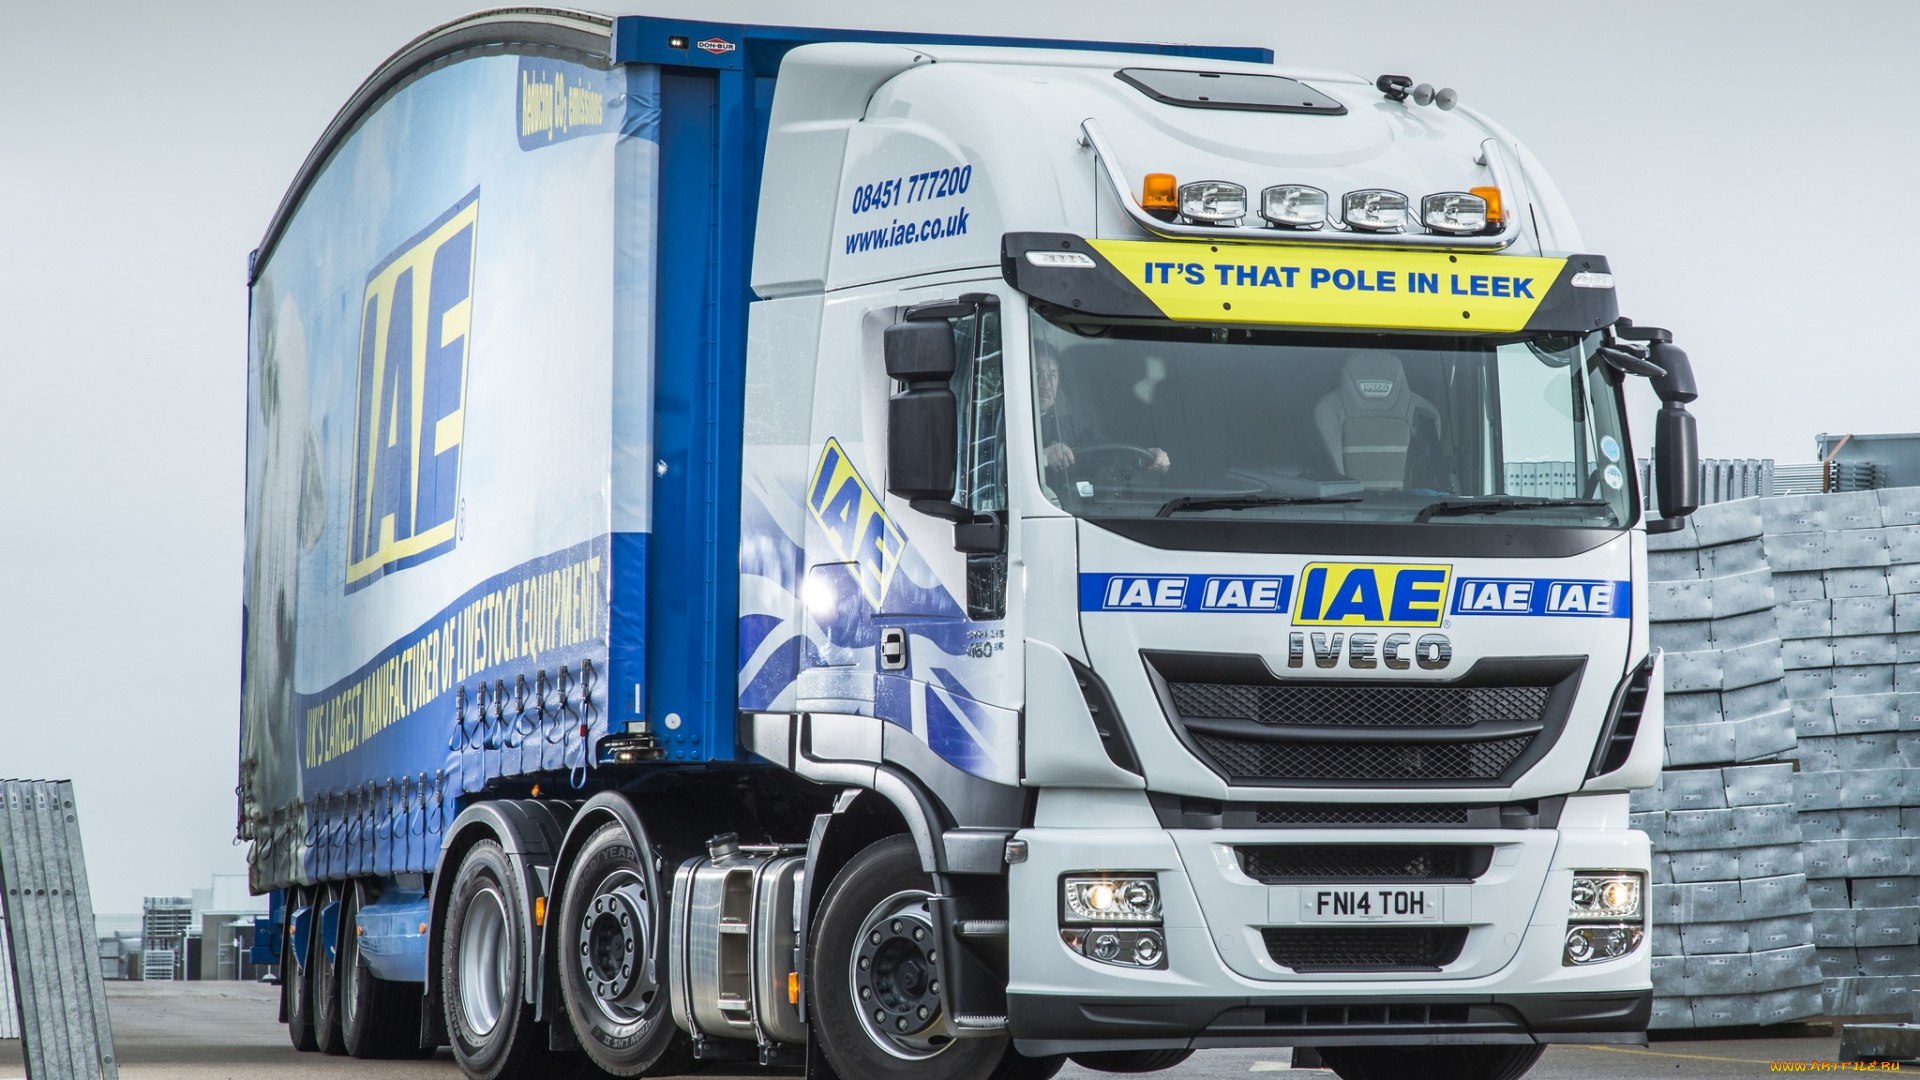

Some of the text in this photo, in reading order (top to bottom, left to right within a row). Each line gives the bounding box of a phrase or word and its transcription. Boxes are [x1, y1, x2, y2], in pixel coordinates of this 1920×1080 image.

[698, 41, 735, 50] DON-BUR
[522, 70, 554, 141] Reducing
[568, 77, 603, 127] emissions
[852, 164, 972, 215] 08451 777200
[845, 206, 970, 255] www.iae.co.uk
[1144, 262, 1535, 299] IT'S THAT POLE IN LEEK
[350, 220, 474, 567] IAE
[811, 446, 901, 603] IAE
[1107, 568, 1614, 622] IAE IAE IAE IAE IAE
[305, 555, 600, 769] UK'S LARGEST MANUFACTURER OF LIVESTOCK EQUIPMENT
[1288, 632, 1452, 670] IVECO
[1316, 890, 1425, 916] FN14 TOH
